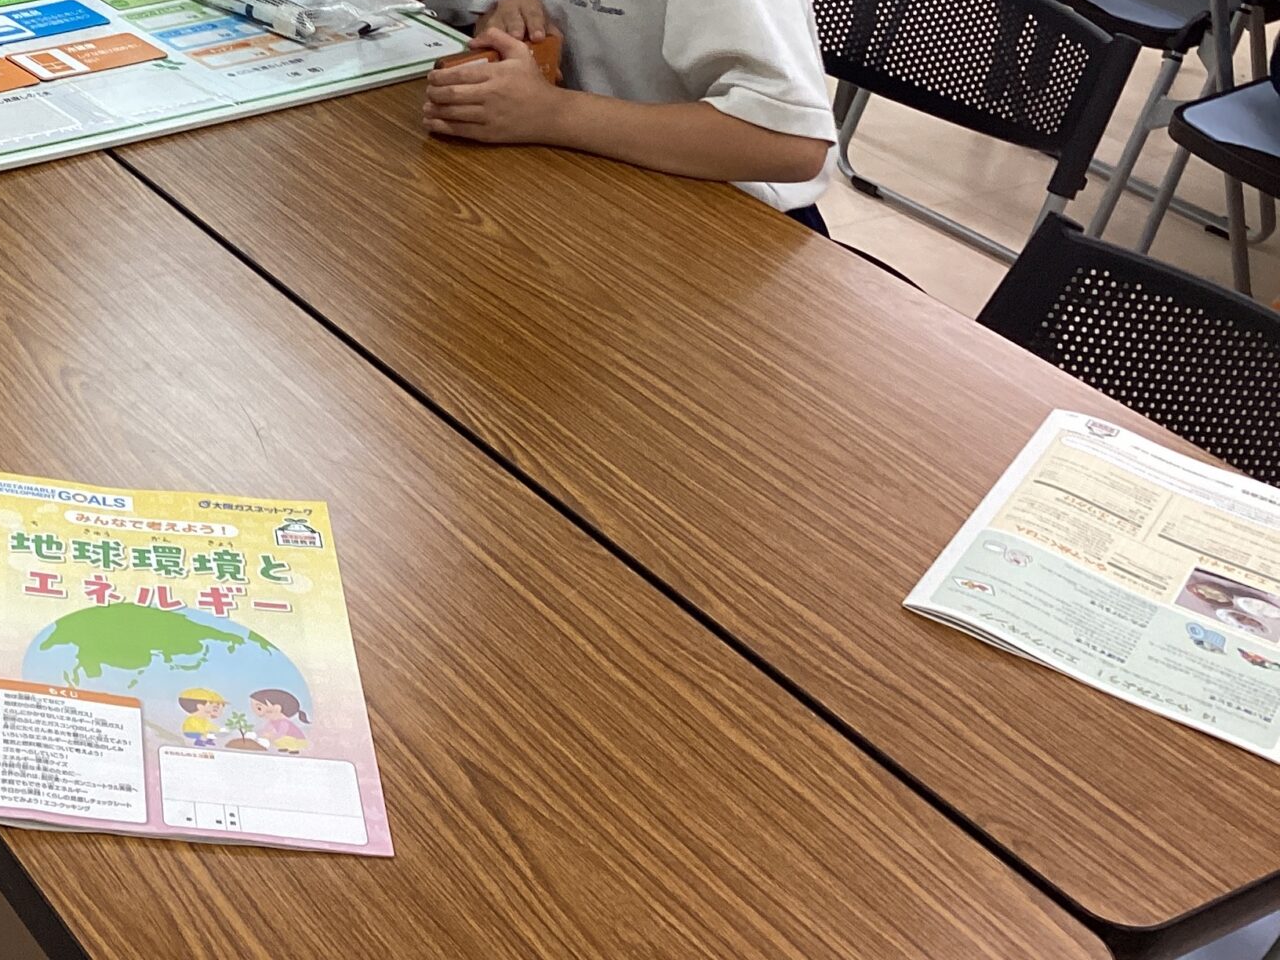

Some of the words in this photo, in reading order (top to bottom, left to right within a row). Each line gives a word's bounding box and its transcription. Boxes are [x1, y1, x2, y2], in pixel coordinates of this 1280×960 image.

[58, 490, 126, 509] GOALS
[11, 532, 293, 583] 地球環境と
[24, 571, 291, 615] エネルギー
[48, 688, 78, 698] もくじ
